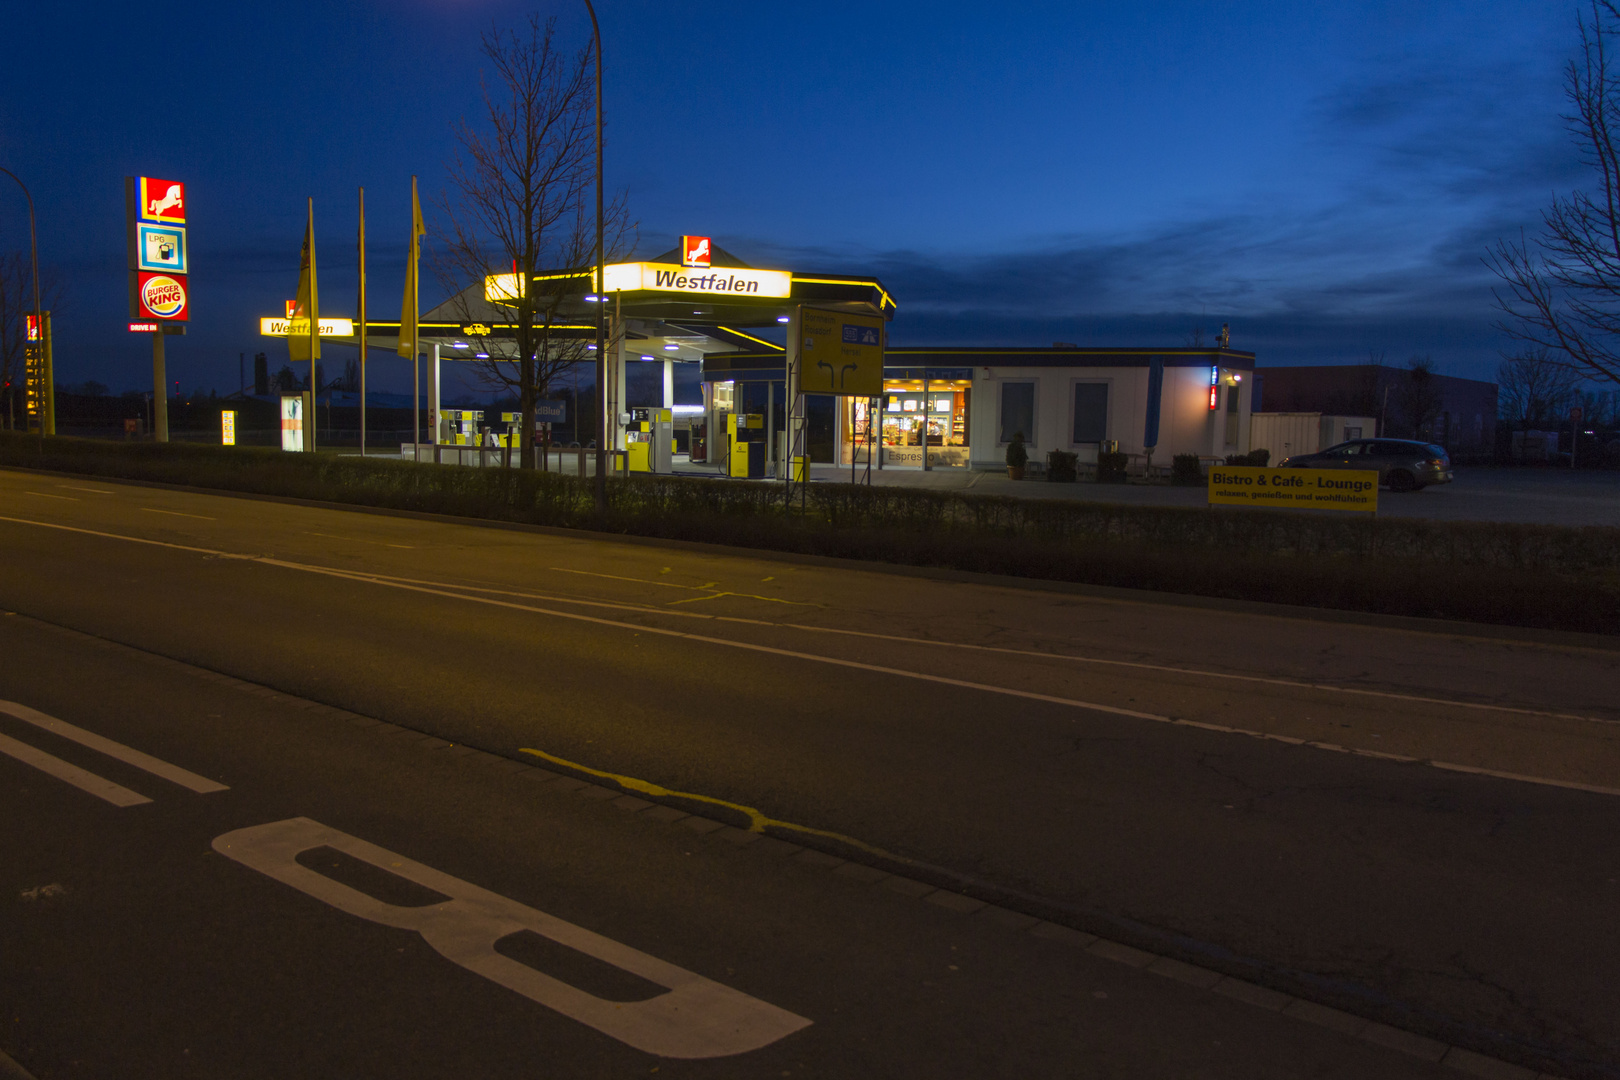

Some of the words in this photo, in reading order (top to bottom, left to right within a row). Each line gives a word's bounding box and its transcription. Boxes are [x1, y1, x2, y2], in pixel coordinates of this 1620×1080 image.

[149, 235, 165, 243] LPG
[656, 270, 759, 293] Westfalen
[147, 285, 180, 297] BURGER
[149, 292, 181, 307] KING
[271, 322, 334, 334] Westfaen
[888, 451, 935, 463] Espreso
[1213, 473, 1253, 485] Bistro
[1257, 475, 1267, 486] &
[1271, 475, 1304, 487] Café
[1317, 477, 1373, 493] Lounge
[1215, 489, 1249, 498] relaxen,
[1251, 491, 1293, 500] genießen
[1295, 493, 1313, 501] und
